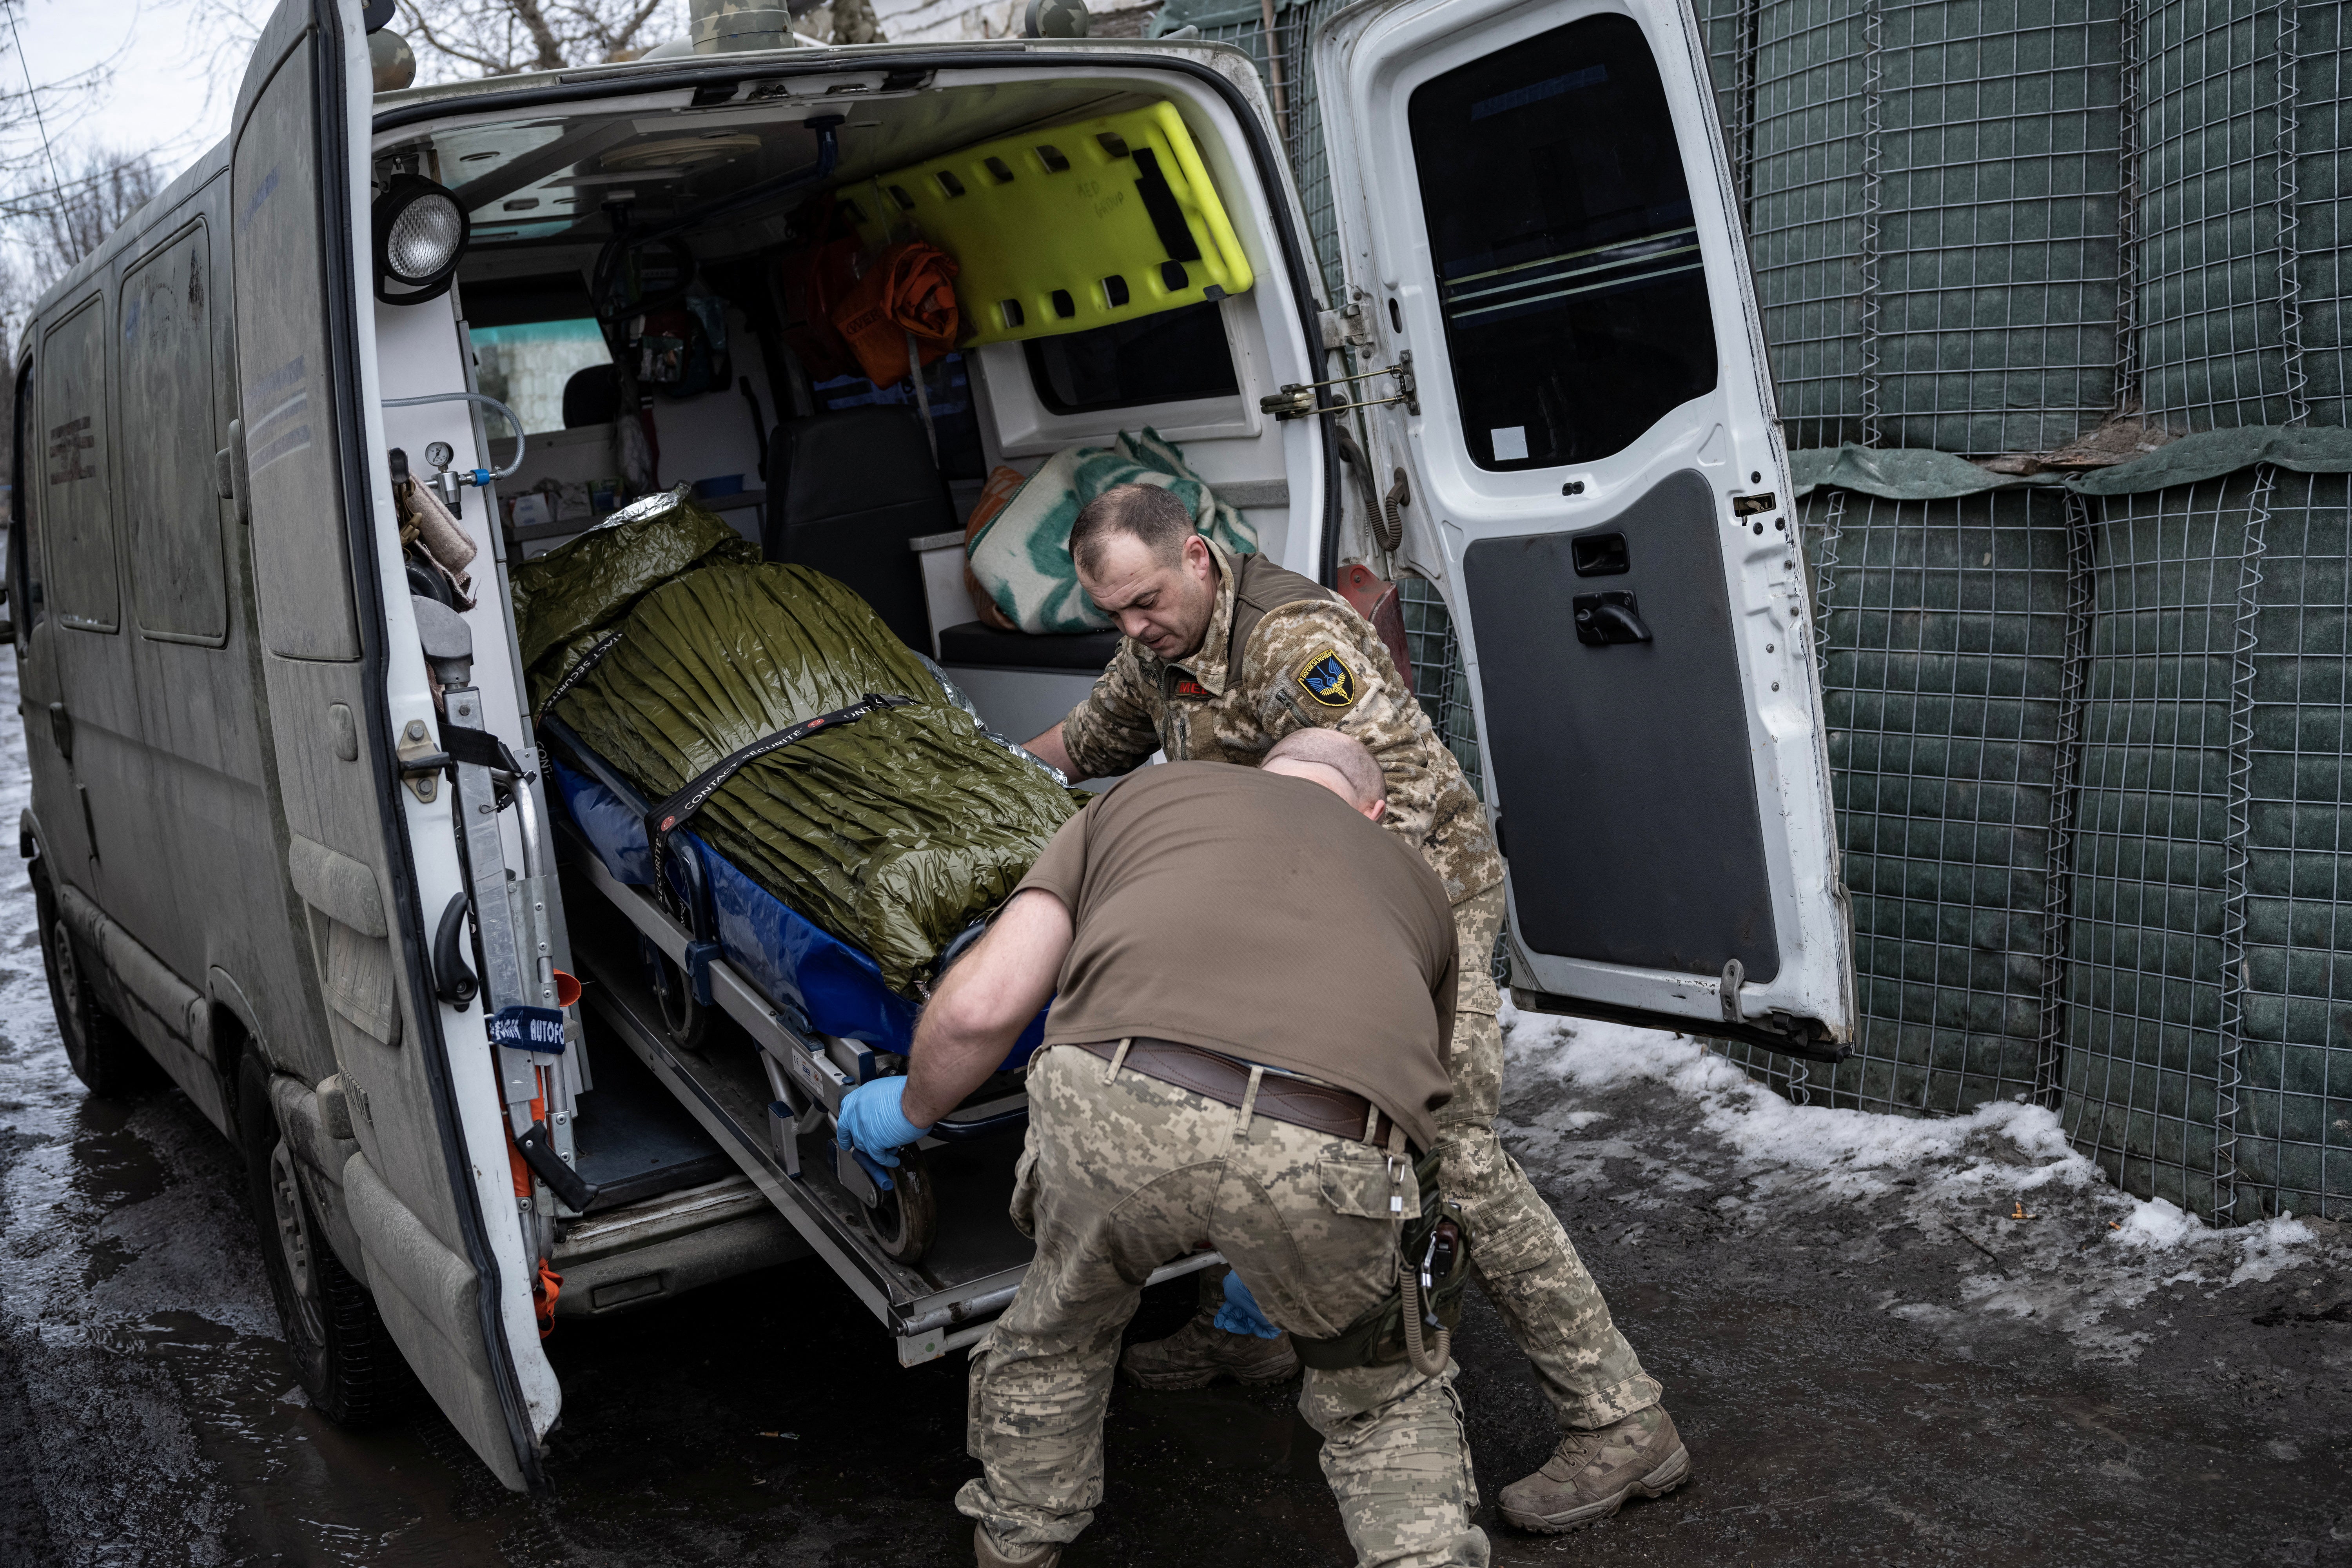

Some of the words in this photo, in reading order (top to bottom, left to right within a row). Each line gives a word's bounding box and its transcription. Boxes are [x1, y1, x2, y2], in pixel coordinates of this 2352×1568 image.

[1302, 663, 1314, 679] БОГОМ
[685, 762, 737, 809] CONTACT
[742, 730, 802, 759] SÉCURITÉ
[530, 1019, 564, 1045] AUTOFO
